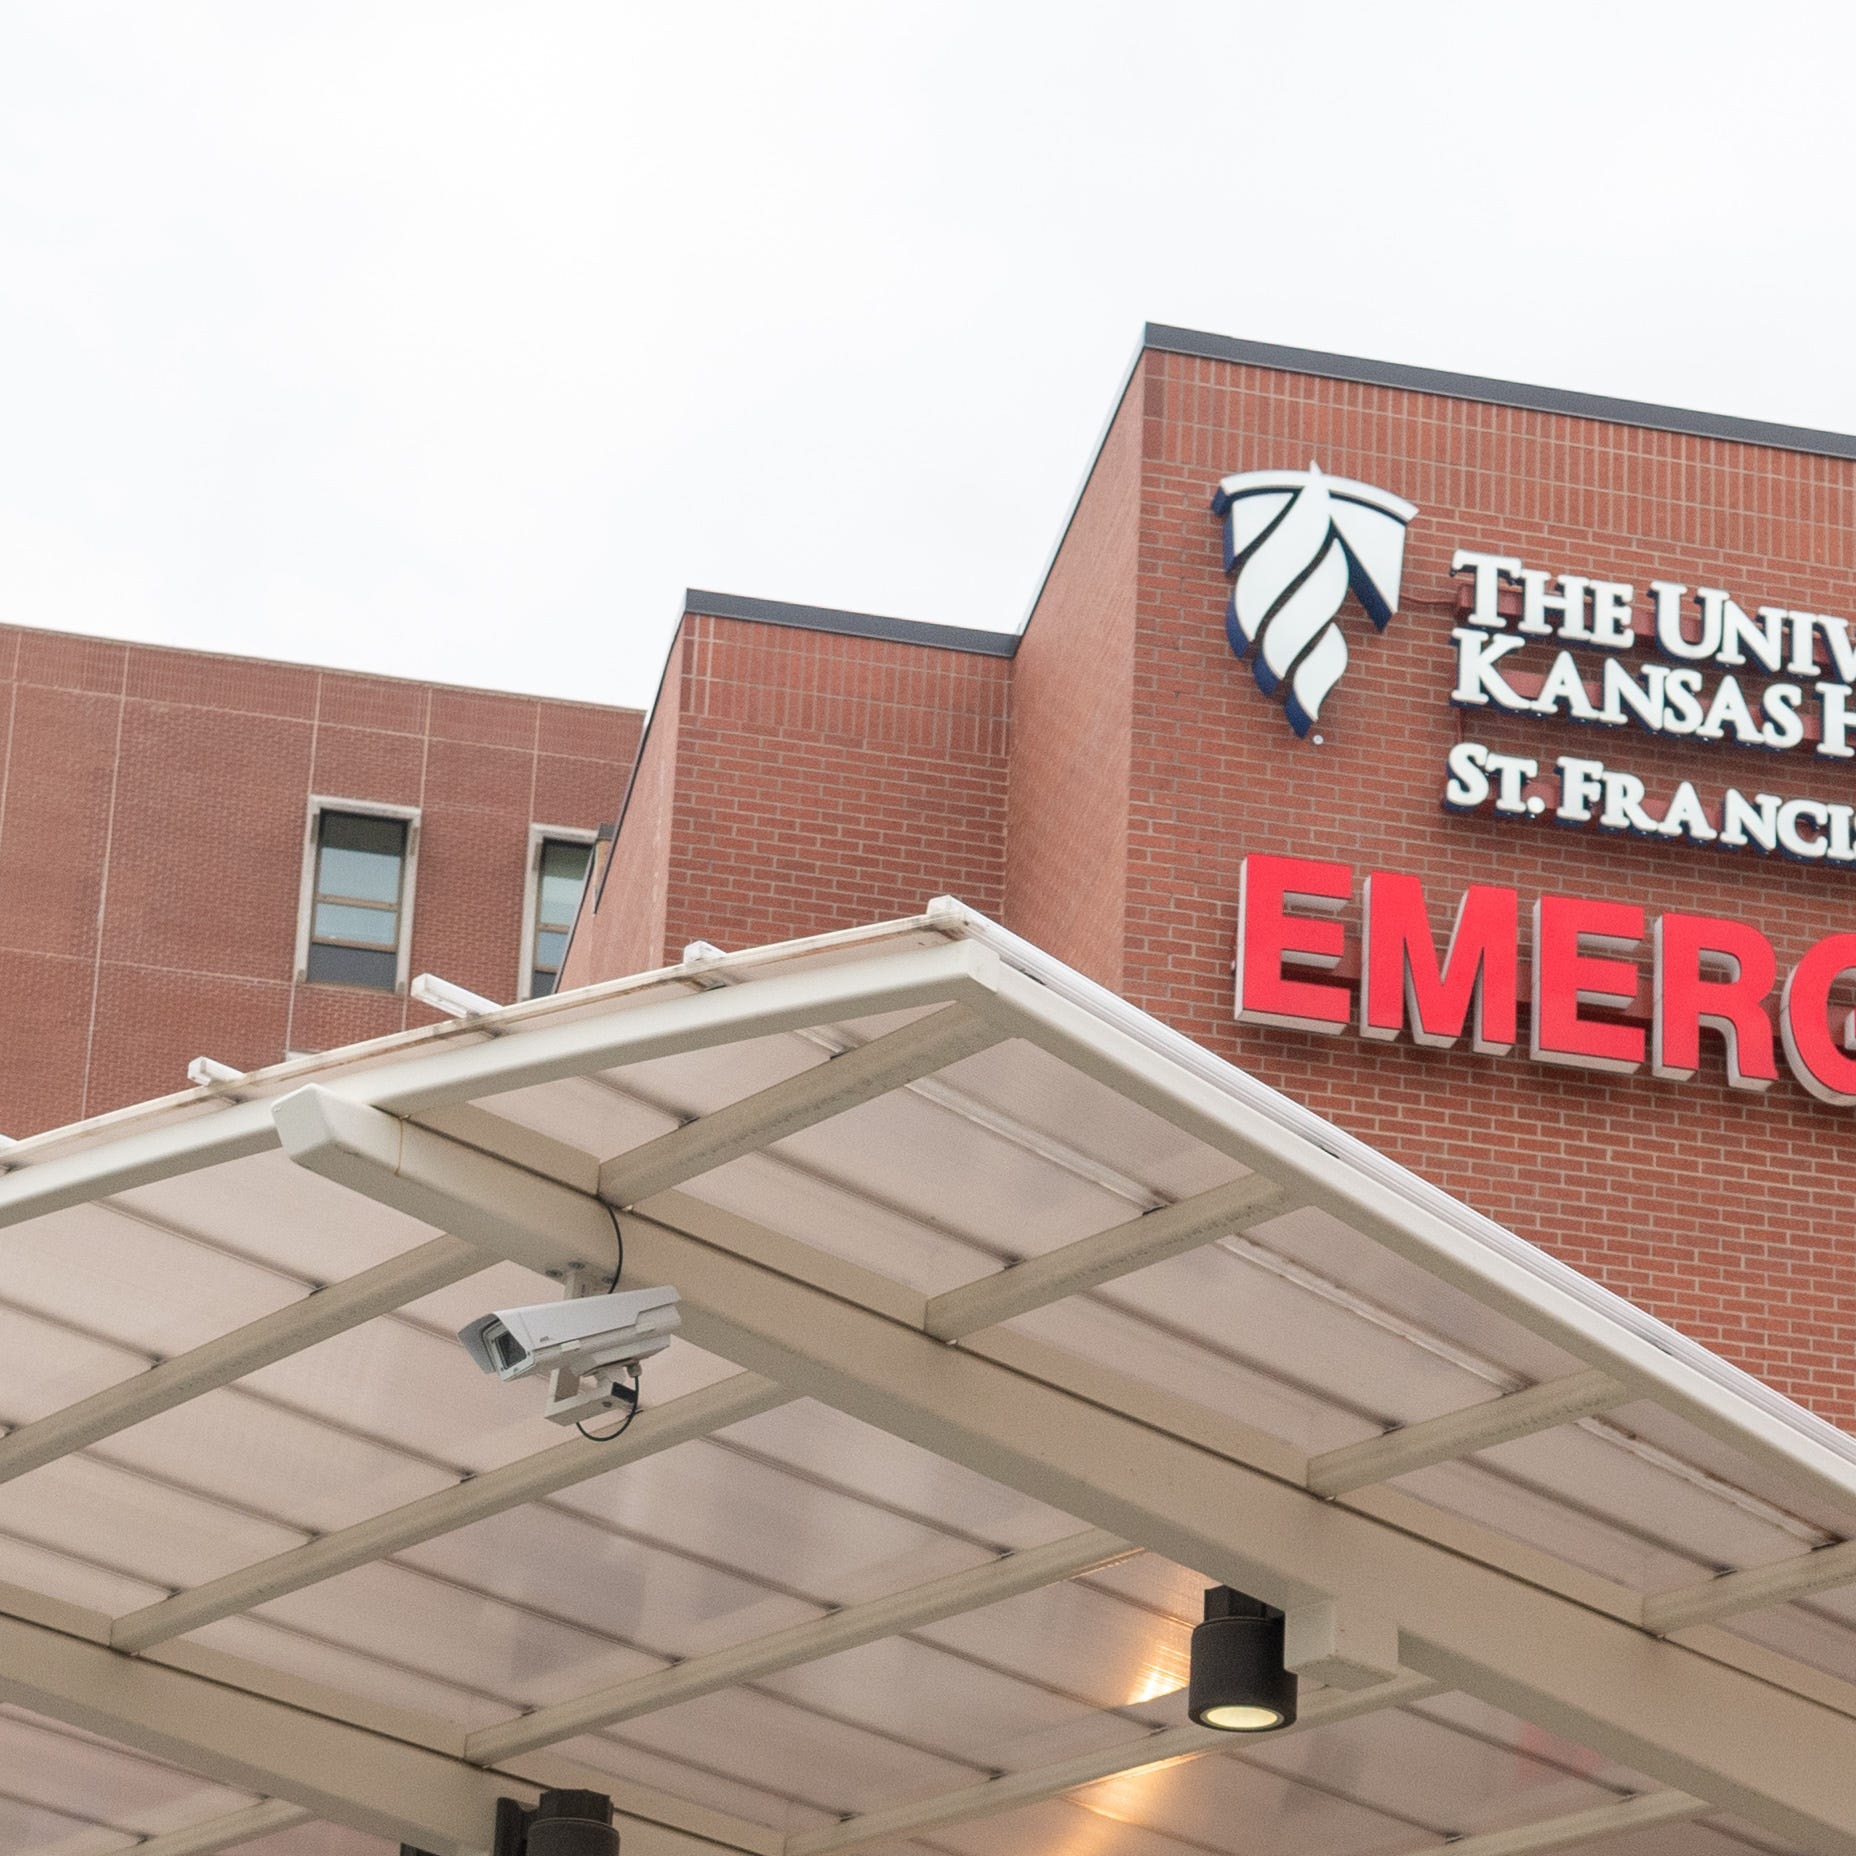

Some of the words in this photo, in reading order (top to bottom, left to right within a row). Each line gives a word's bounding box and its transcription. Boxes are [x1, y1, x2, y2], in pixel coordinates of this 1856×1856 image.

[1451, 550, 1633, 649] THE
[1451, 626, 1804, 750] KANSAS
[1446, 742, 1544, 818] ST.
